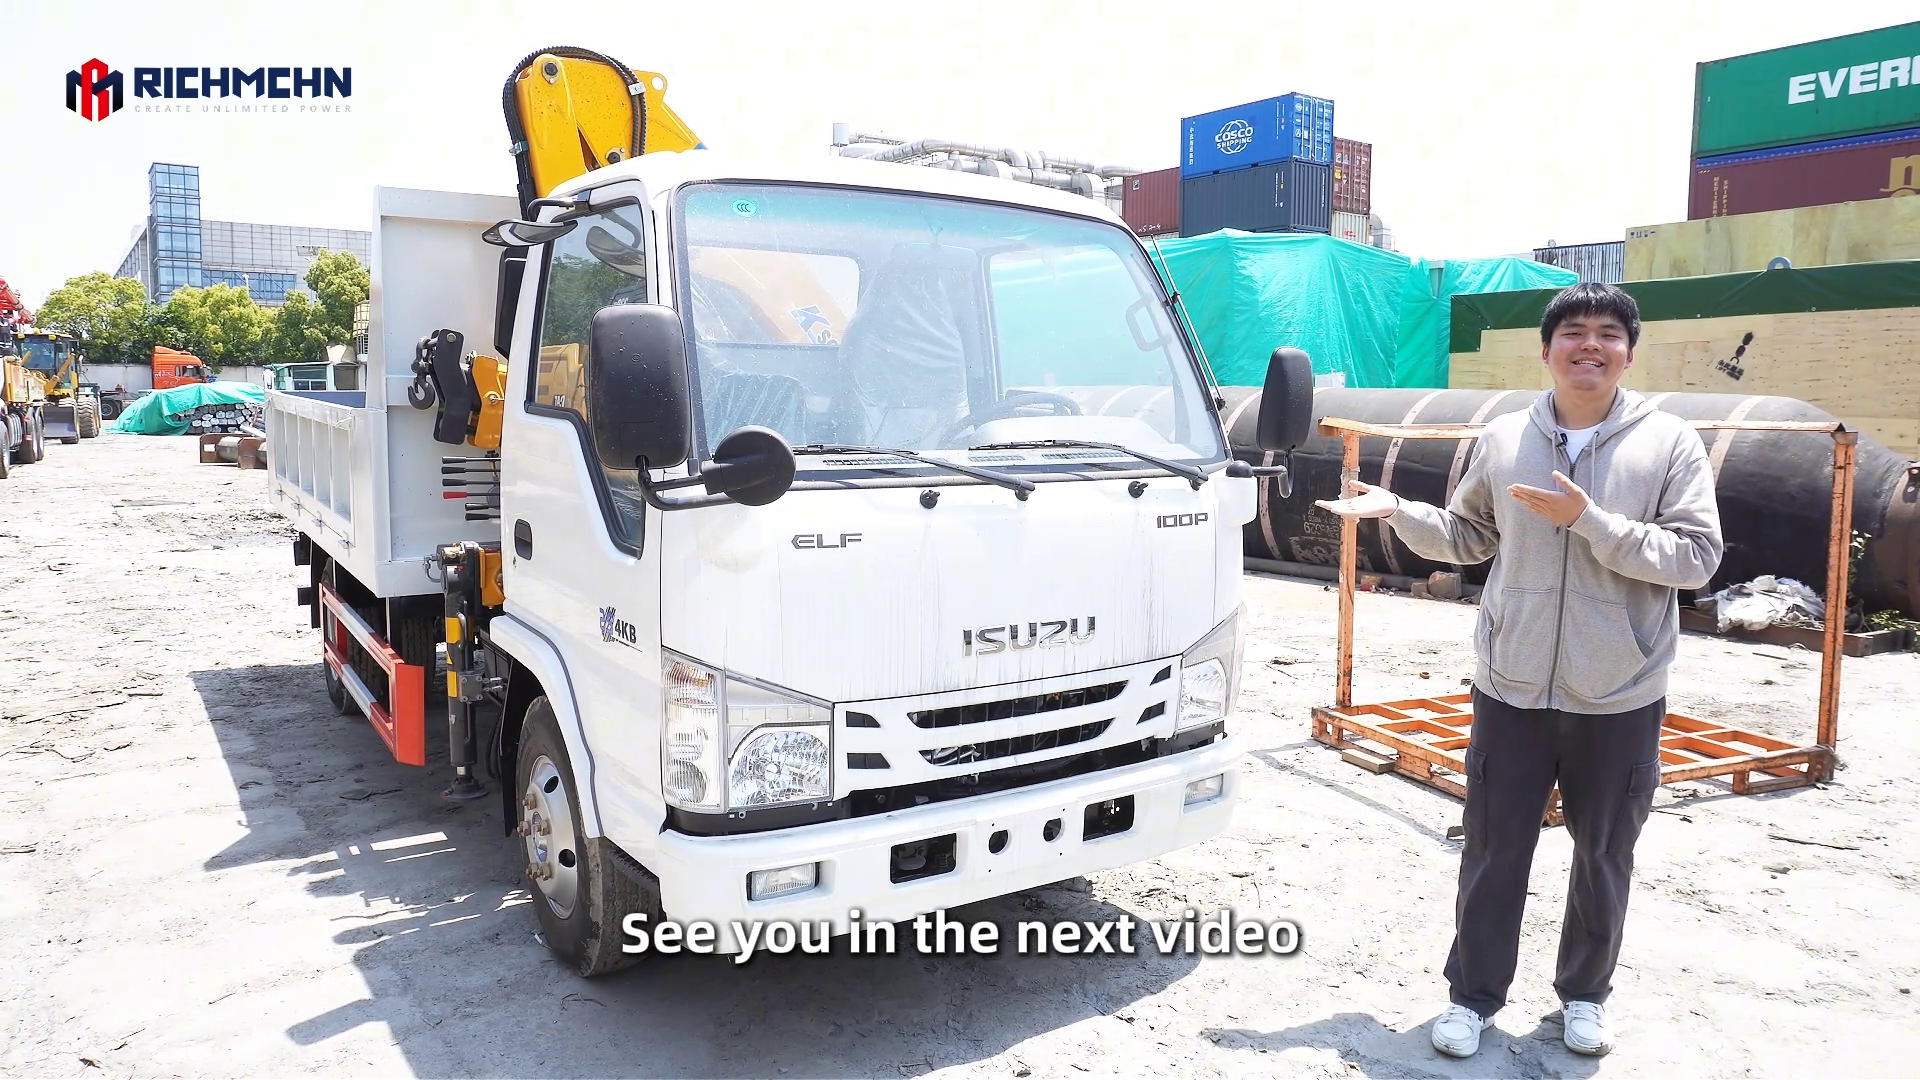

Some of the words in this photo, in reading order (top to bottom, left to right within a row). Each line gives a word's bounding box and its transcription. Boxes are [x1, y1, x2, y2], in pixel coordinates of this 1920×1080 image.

[1214, 125, 1254, 143] COSCO
[1216, 137, 1253, 148] SHIPPING
[1156, 512, 1209, 529] 100P
[790, 532, 863, 550] ELF
[614, 618, 637, 644] 4KB
[962, 615, 1096, 657] ISUZU
